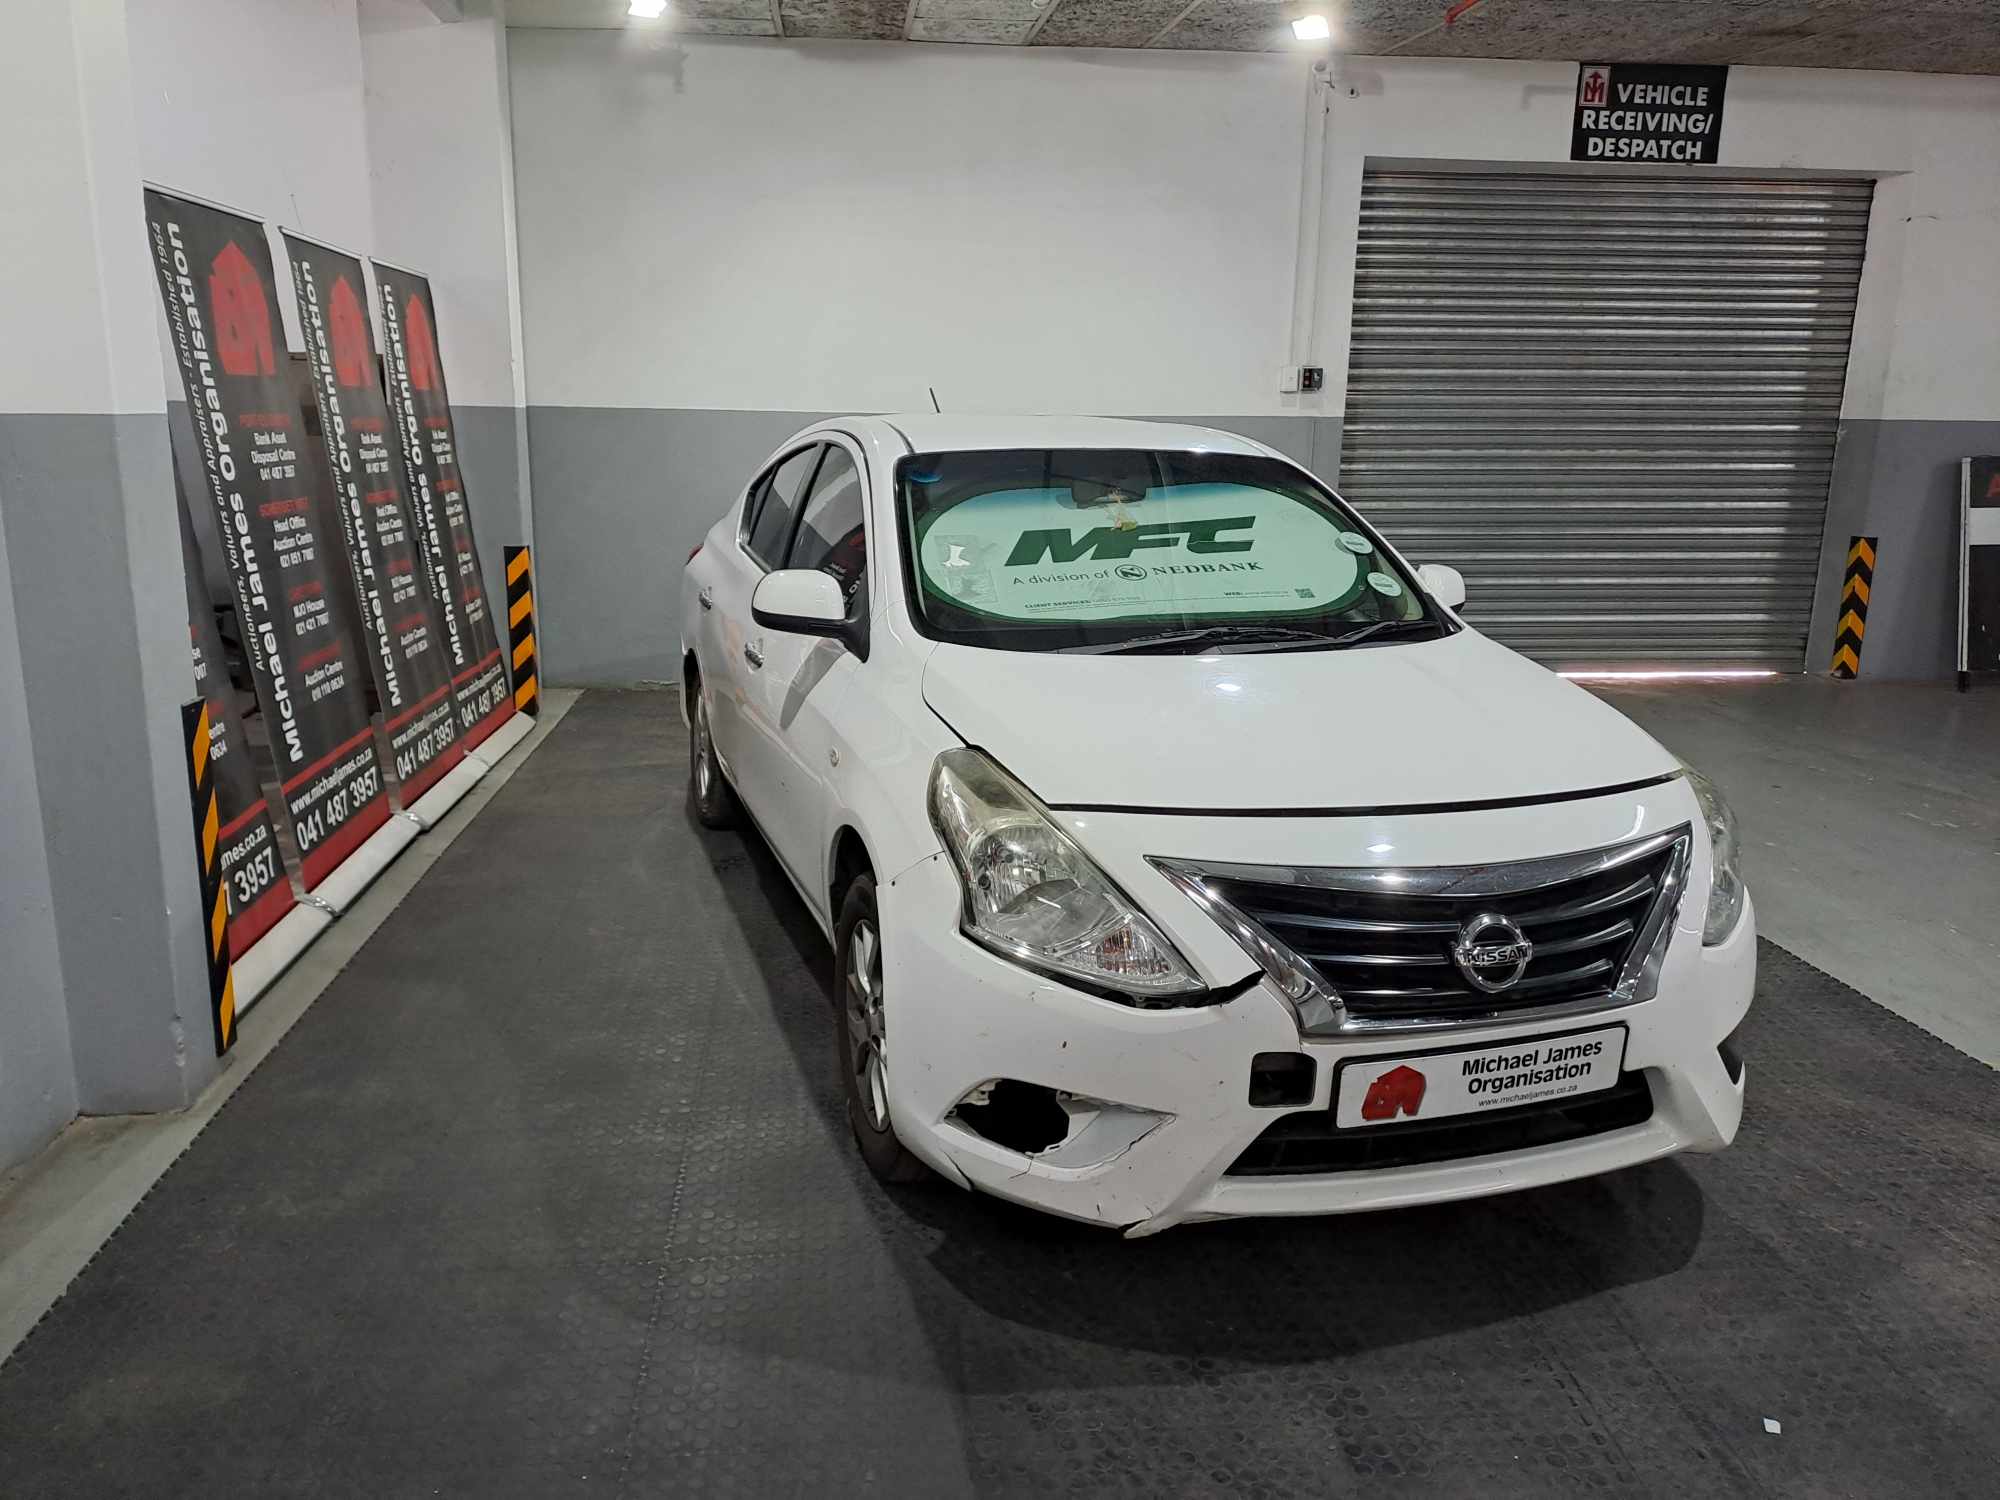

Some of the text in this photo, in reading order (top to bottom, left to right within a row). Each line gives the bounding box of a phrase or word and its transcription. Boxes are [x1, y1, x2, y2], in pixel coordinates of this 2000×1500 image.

[1582, 109, 1714, 134] RECEIVING/
[1617, 83, 1709, 107] VEHICLE
[1587, 137, 1703, 160] DESPATCH
[302, 261, 352, 473] Organisation
[384, 284, 423, 466] Organisation
[152, 221, 264, 671] Auctioneers, Valuers and Appraisers Established 1964
[167, 222, 304, 763] Michael James Organisation
[418, 473, 442, 558] James
[347, 482, 375, 581] James
[1004, 516, 1256, 566] MFC
[1013, 561, 1264, 585] A division of NEDBANK
[434, 565, 464, 665] Michael
[367, 589, 402, 707] Michael
[461, 699, 478, 727] 041
[396, 717, 455, 780] 041 487 3957
[297, 766, 378, 850] 041 487 3957
[234, 846, 275, 902] 3957
[1466, 946, 1526, 963] NISSAN
[1462, 1041, 1603, 1076] Michael James
[1468, 1062, 1591, 1094] Organisation
